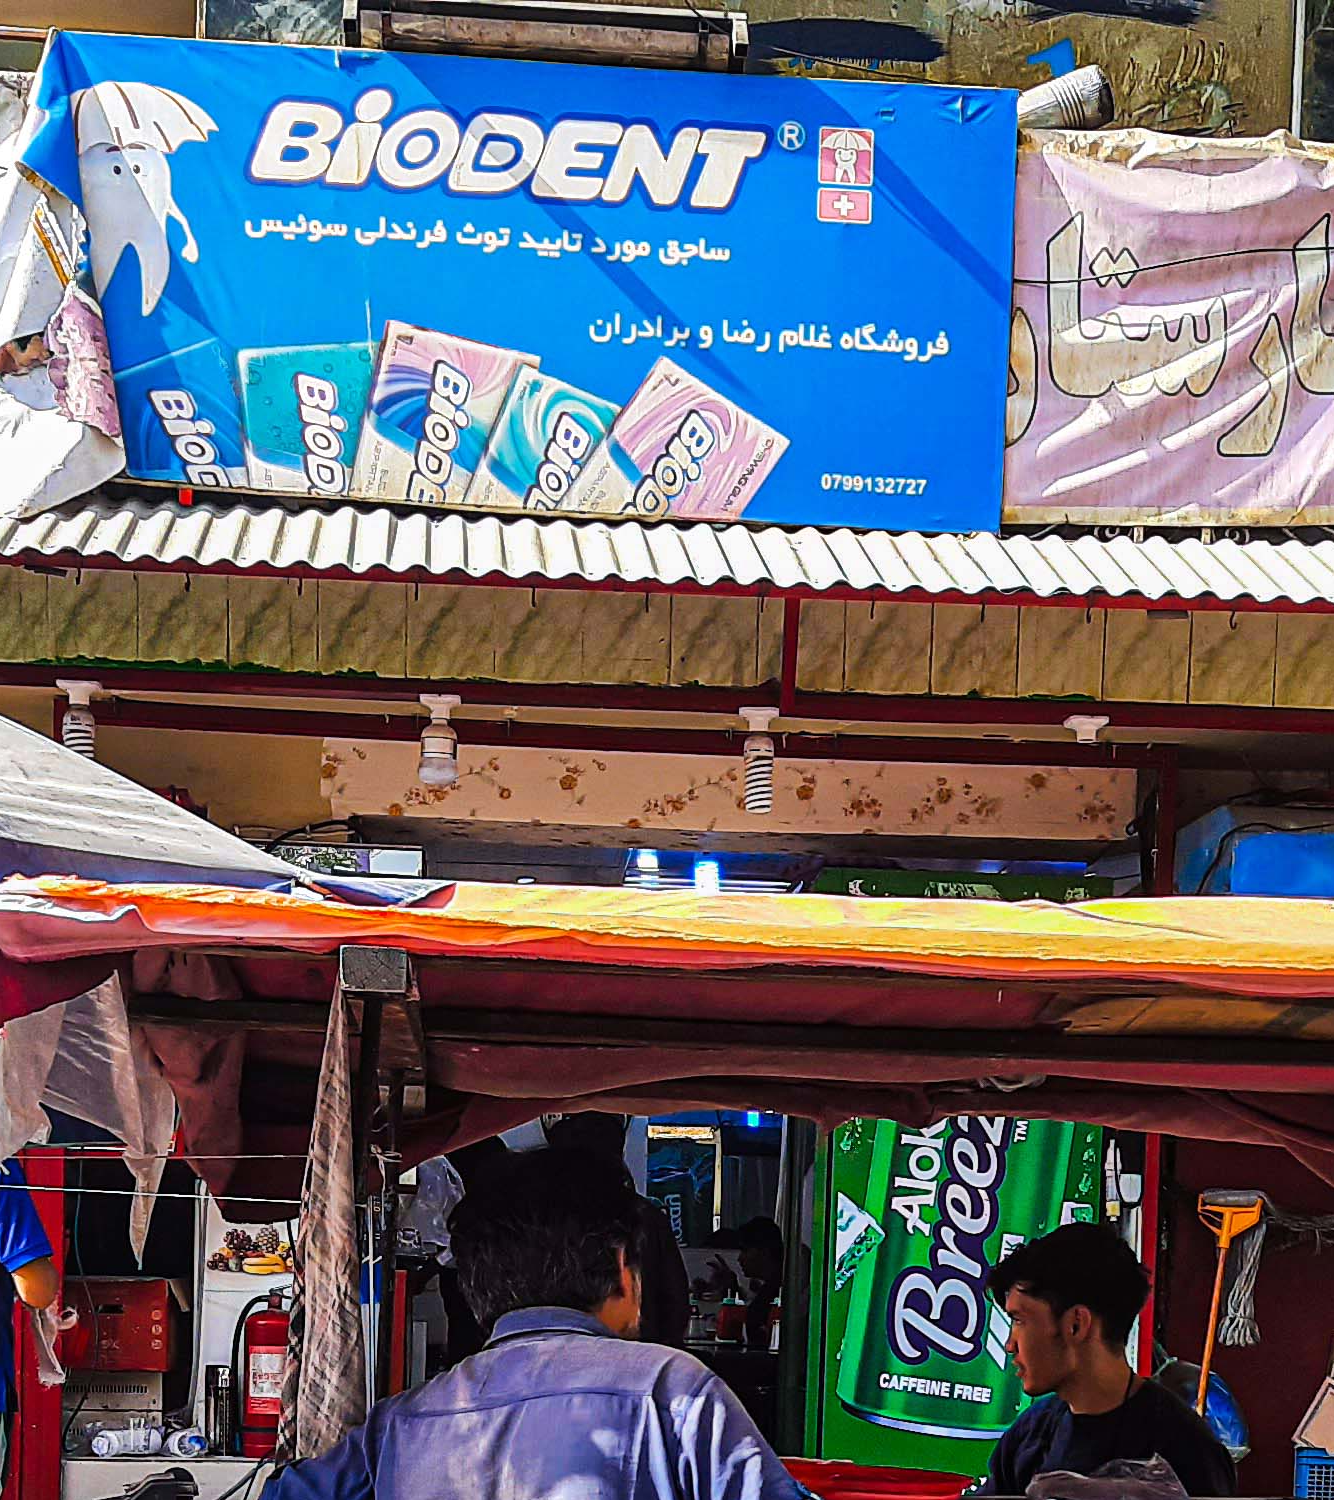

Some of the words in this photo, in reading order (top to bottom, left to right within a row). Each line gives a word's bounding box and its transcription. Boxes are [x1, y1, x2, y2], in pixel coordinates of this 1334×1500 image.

[355, 216, 447, 249] فرندلی
[456, 223, 511, 252] توث
[518, 229, 583, 258] تایید
[591, 237, 651, 263] مورد
[659, 237, 731, 266] ساجق
[589, 313, 691, 347] برادران
[699, 324, 714, 349] و
[722, 319, 771, 352] رضا
[779, 323, 832, 352] غلام
[840, 323, 949, 362] فروشگاه
[820, 473, 927, 495] 0799132727
[879, 1373, 952, 1397] CAFFEINE
[953, 1383, 992, 1403] FREE
